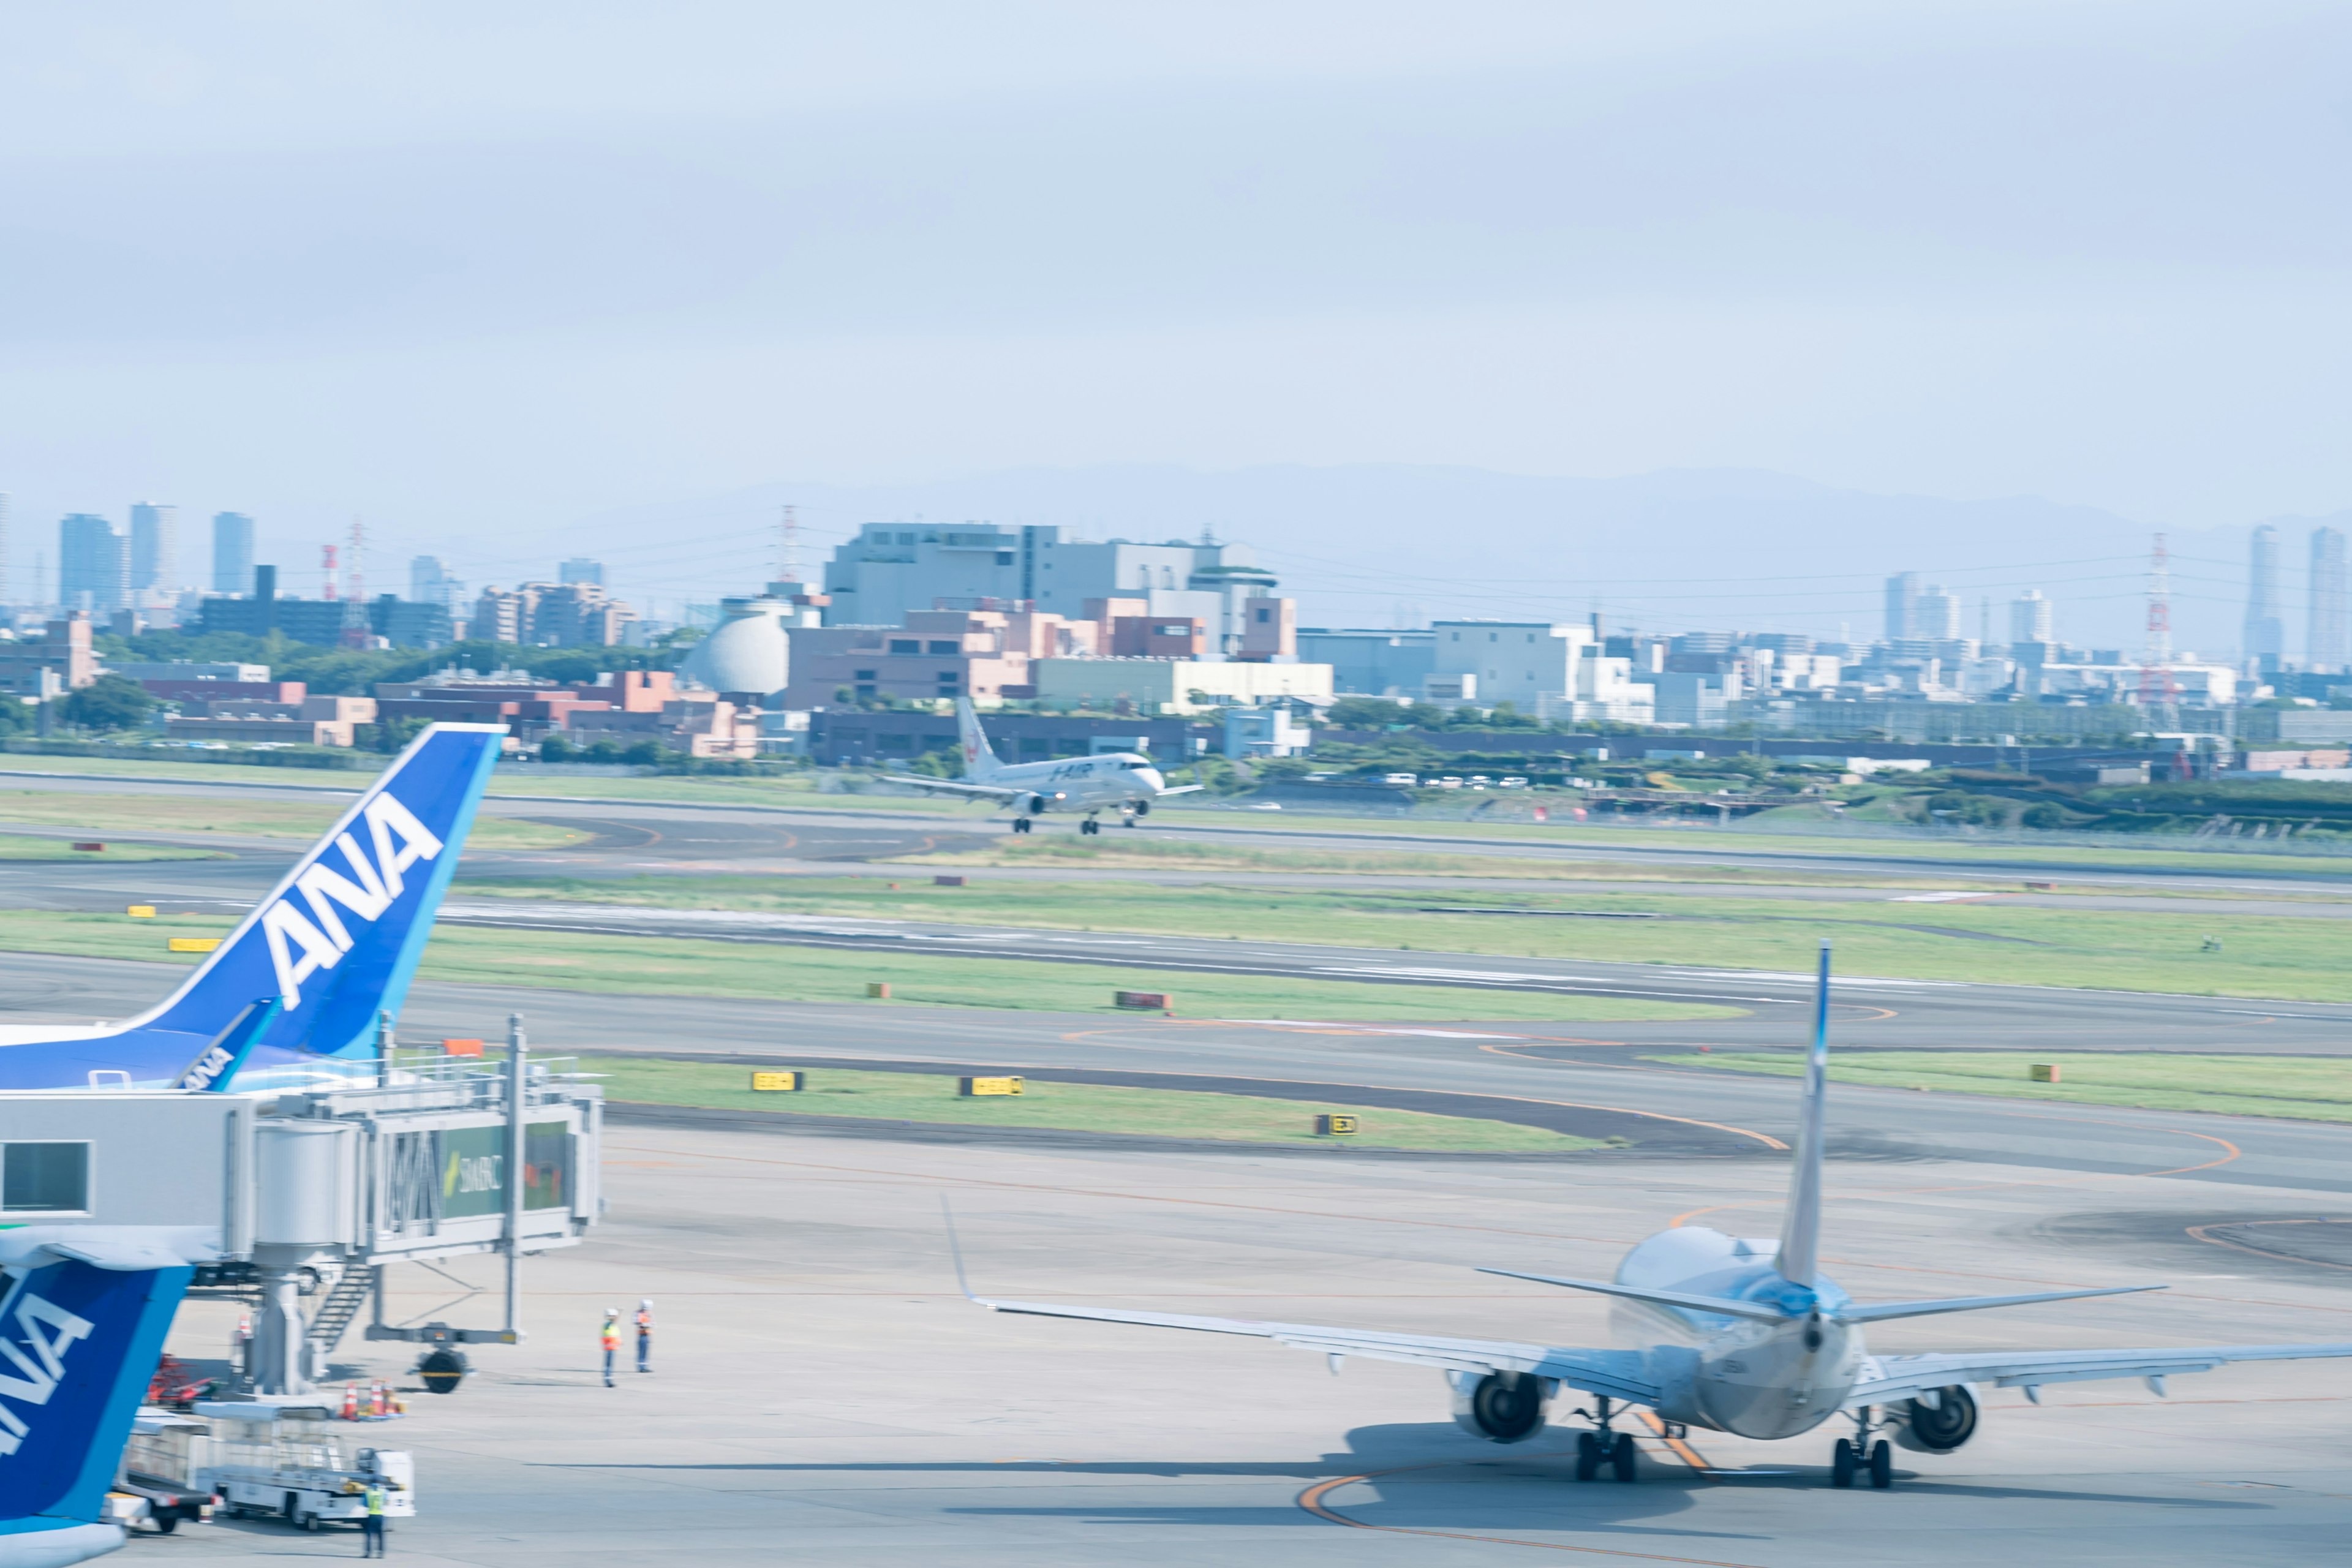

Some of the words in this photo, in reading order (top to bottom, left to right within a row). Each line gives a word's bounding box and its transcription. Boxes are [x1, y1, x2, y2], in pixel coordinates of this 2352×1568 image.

[262, 791, 445, 1012] ANA
[184, 1046, 235, 1090] ANA
[0, 1292, 96, 1457] NA
